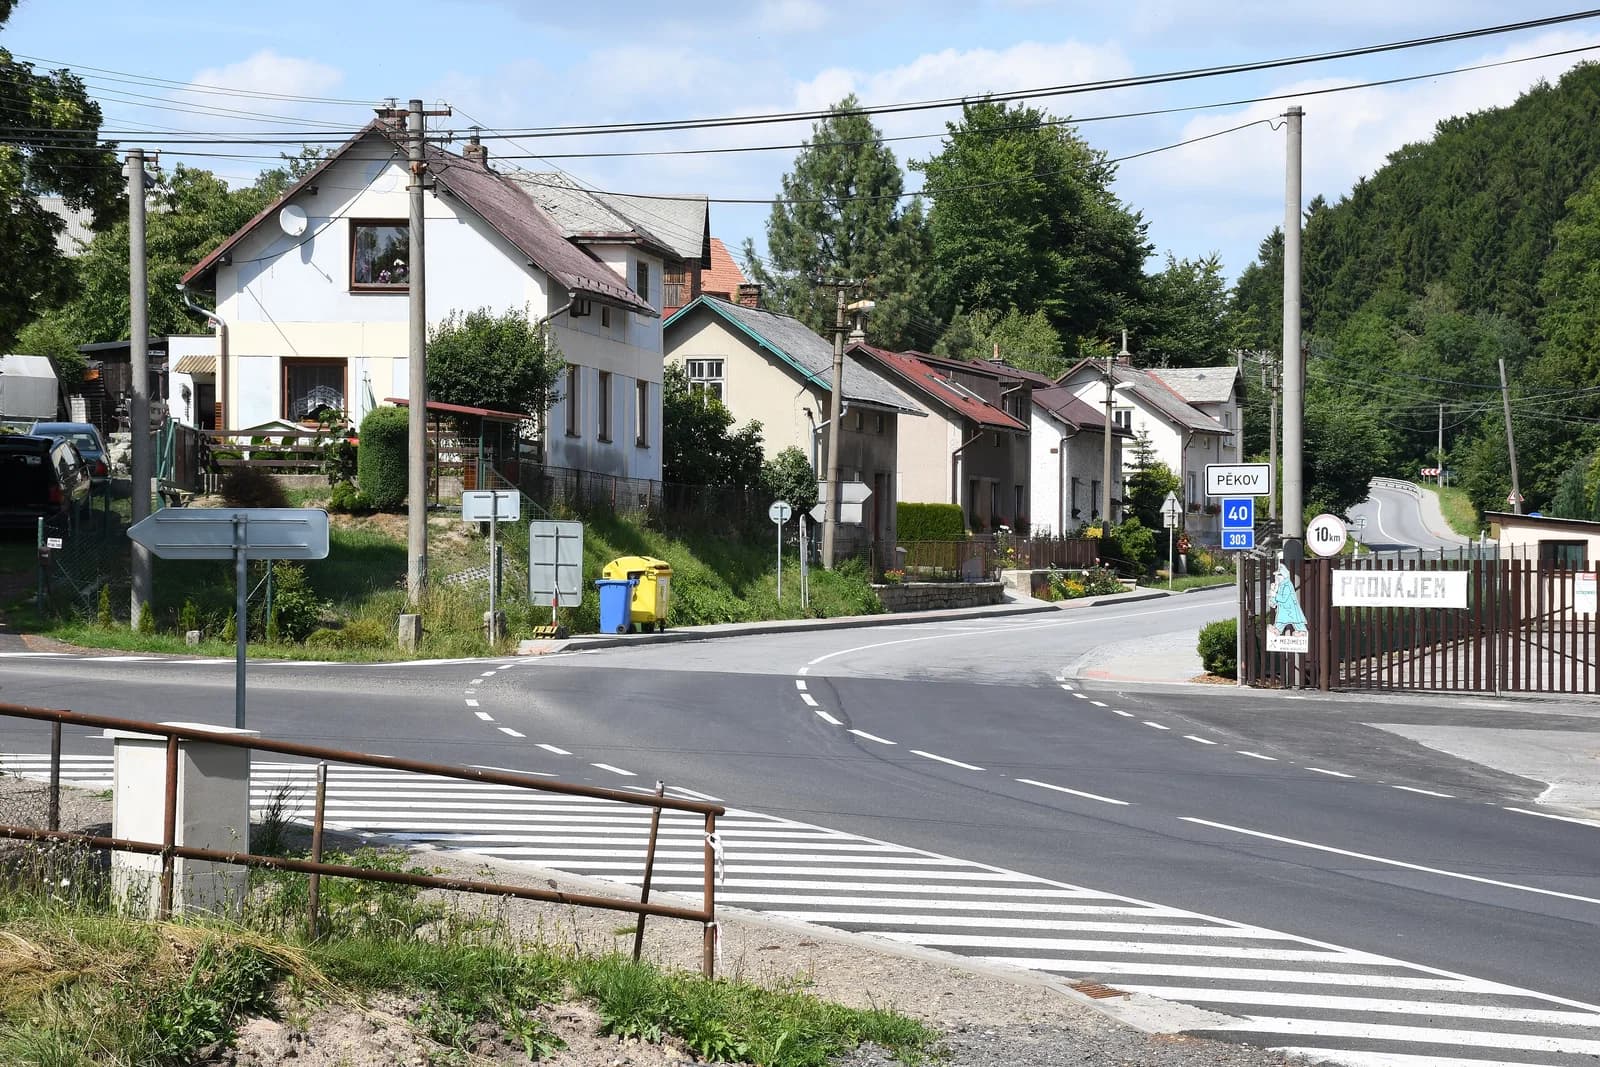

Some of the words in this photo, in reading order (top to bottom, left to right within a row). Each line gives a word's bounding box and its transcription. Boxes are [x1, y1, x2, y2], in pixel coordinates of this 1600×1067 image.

[1217, 472, 1259, 486] PĚKOV
[1228, 506, 1248, 521] 40
[1229, 534, 1247, 545] 303
[1340, 572, 1446, 599] PRONÁJEM
